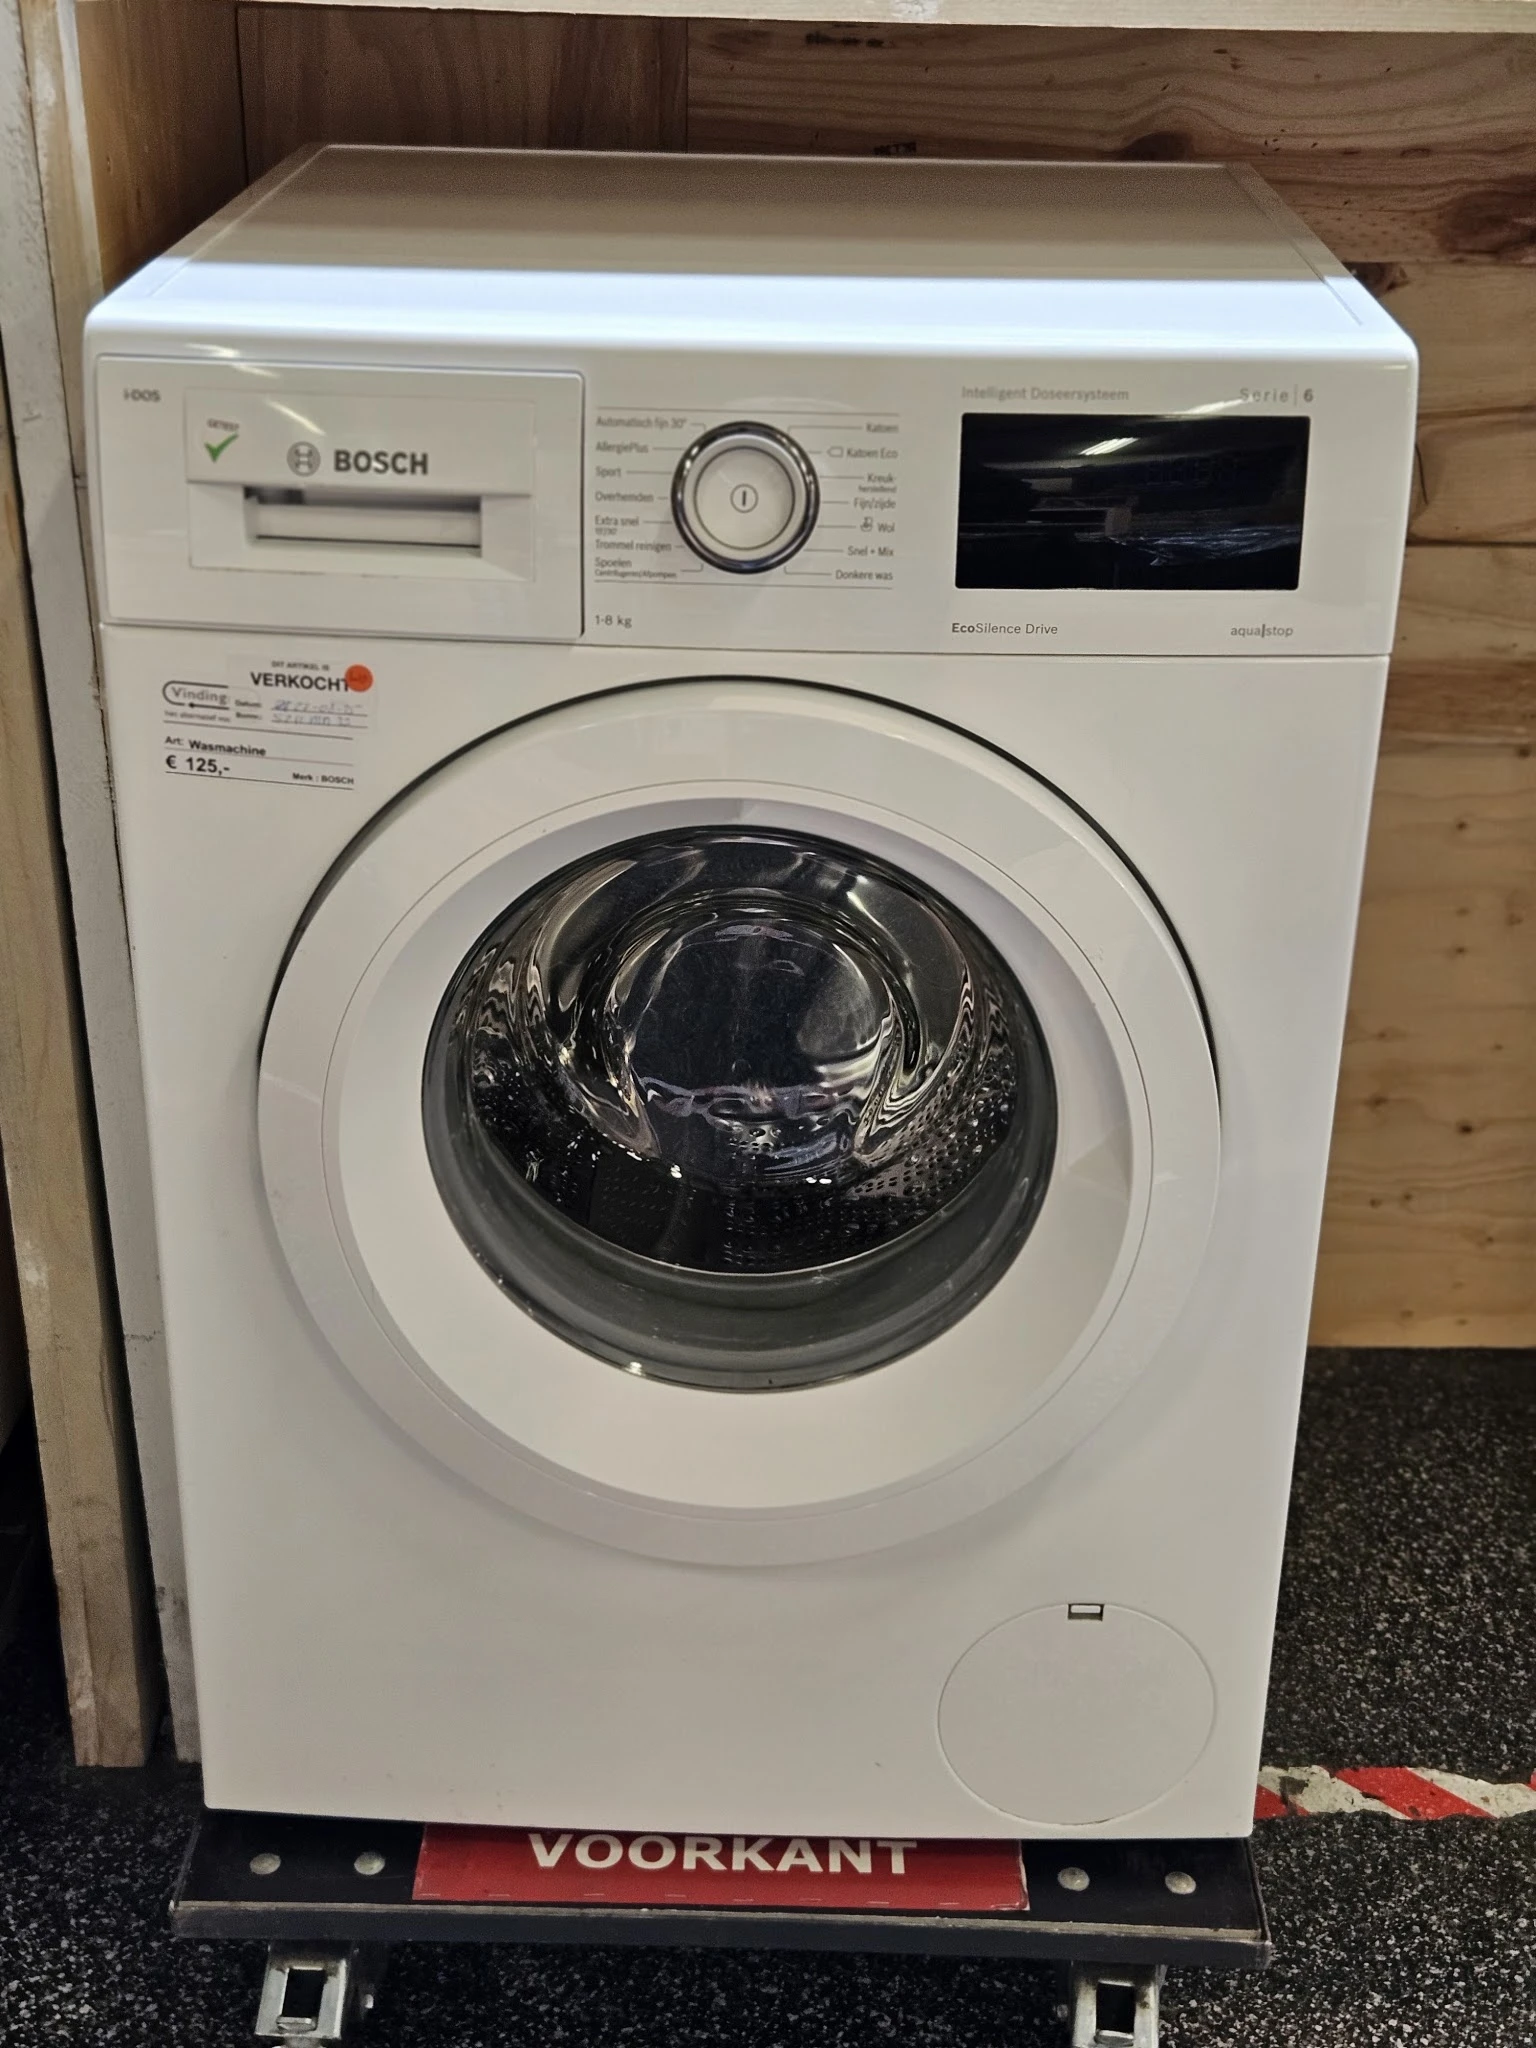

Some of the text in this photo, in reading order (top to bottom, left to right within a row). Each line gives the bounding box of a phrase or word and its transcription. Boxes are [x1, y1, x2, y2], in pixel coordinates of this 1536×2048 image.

[961, 385, 1130, 403] Intelligent Doseersysteem
[1240, 387, 1314, 403] Serie 6
[595, 416, 652, 429] Automatisch
[866, 423, 899, 433] Katoen
[595, 441, 649, 454] AllergiePlus
[847, 447, 898, 459] Katoen Eco
[334, 449, 429, 476] BOSCH
[595, 465, 621, 478] Sport
[595, 491, 654, 503] Overhemden
[595, 514, 640, 527] Extra snel
[877, 521, 895, 533] Wol
[595, 538, 672, 554] Trommel reinigen
[847, 545, 868, 556] Snel
[877, 547, 894, 557] Mix
[595, 556, 633, 569] Spoelen
[835, 569, 894, 581] Donkere was
[595, 614, 632, 629] 1-8 kg
[951, 622, 1058, 635] EcoSilence Drive
[249, 671, 349, 693] VERKOCHT
[188, 739, 267, 757] Wasmachine
[165, 754, 231, 777] € 125,-
[292, 772, 313, 781] Merk
[320, 774, 355, 785] BOSCH
[528, 1832, 918, 1875] VOORKANT
